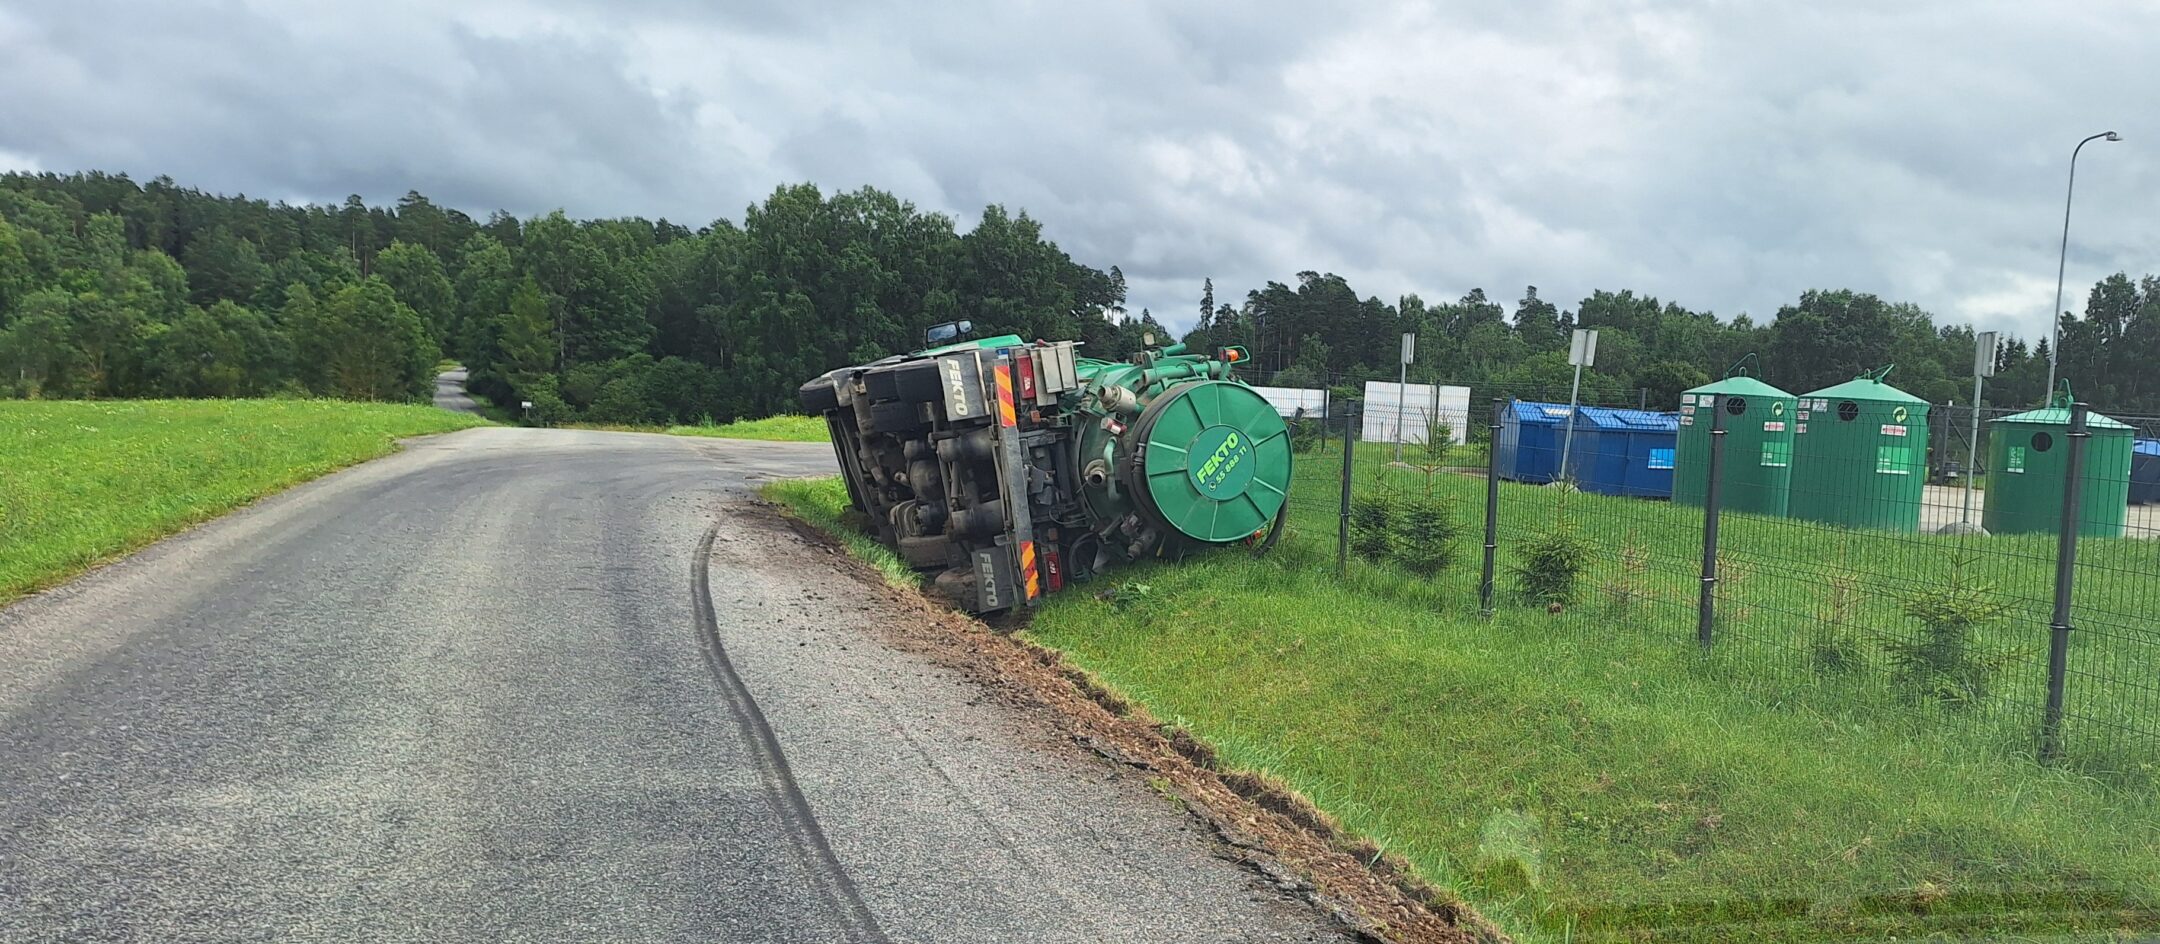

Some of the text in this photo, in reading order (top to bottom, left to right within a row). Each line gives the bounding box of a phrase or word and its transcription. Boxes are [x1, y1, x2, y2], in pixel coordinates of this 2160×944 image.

[946, 359, 968, 416] FEKTO
[1196, 432, 1239, 485] FEKTO
[1215, 470, 1226, 484] 55
[1225, 454, 1240, 473] 888
[979, 553, 998, 607] FEKTO
